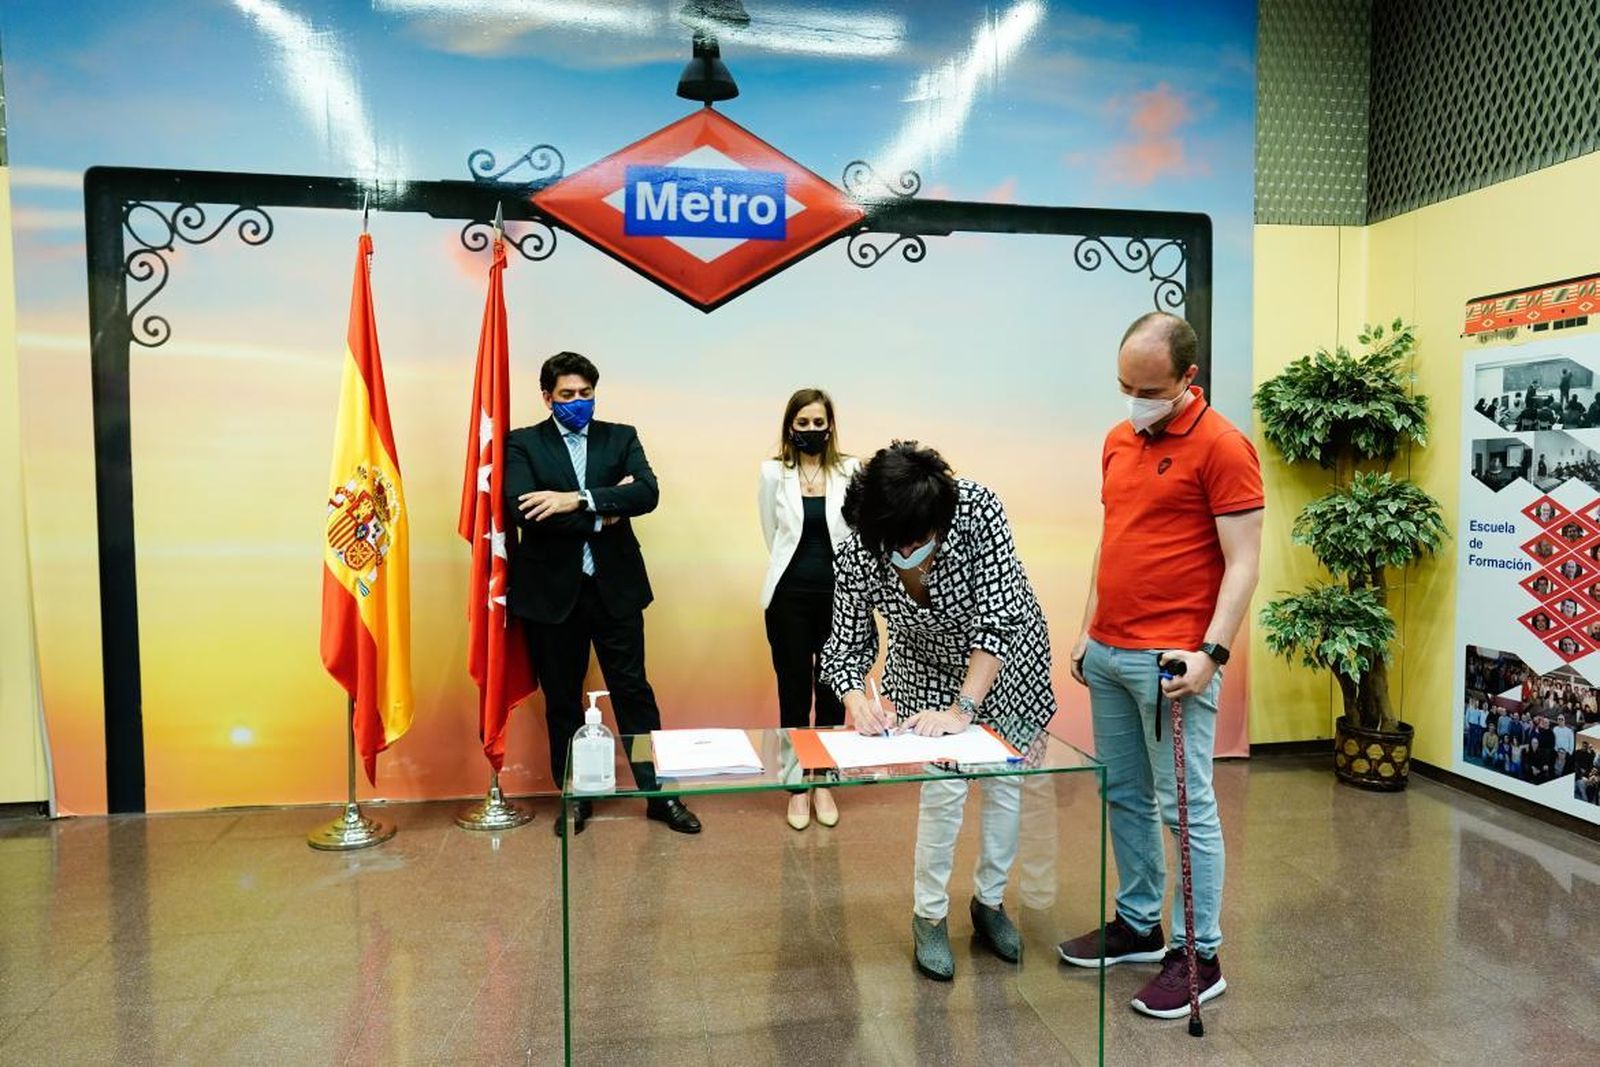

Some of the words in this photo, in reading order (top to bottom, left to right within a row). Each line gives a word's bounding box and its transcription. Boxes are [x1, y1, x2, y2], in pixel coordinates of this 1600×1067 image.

[635, 181, 778, 225] Metro
[1469, 519, 1516, 535] Escuela
[1468, 537, 1484, 550] de
[1468, 554, 1532, 572] Formación
